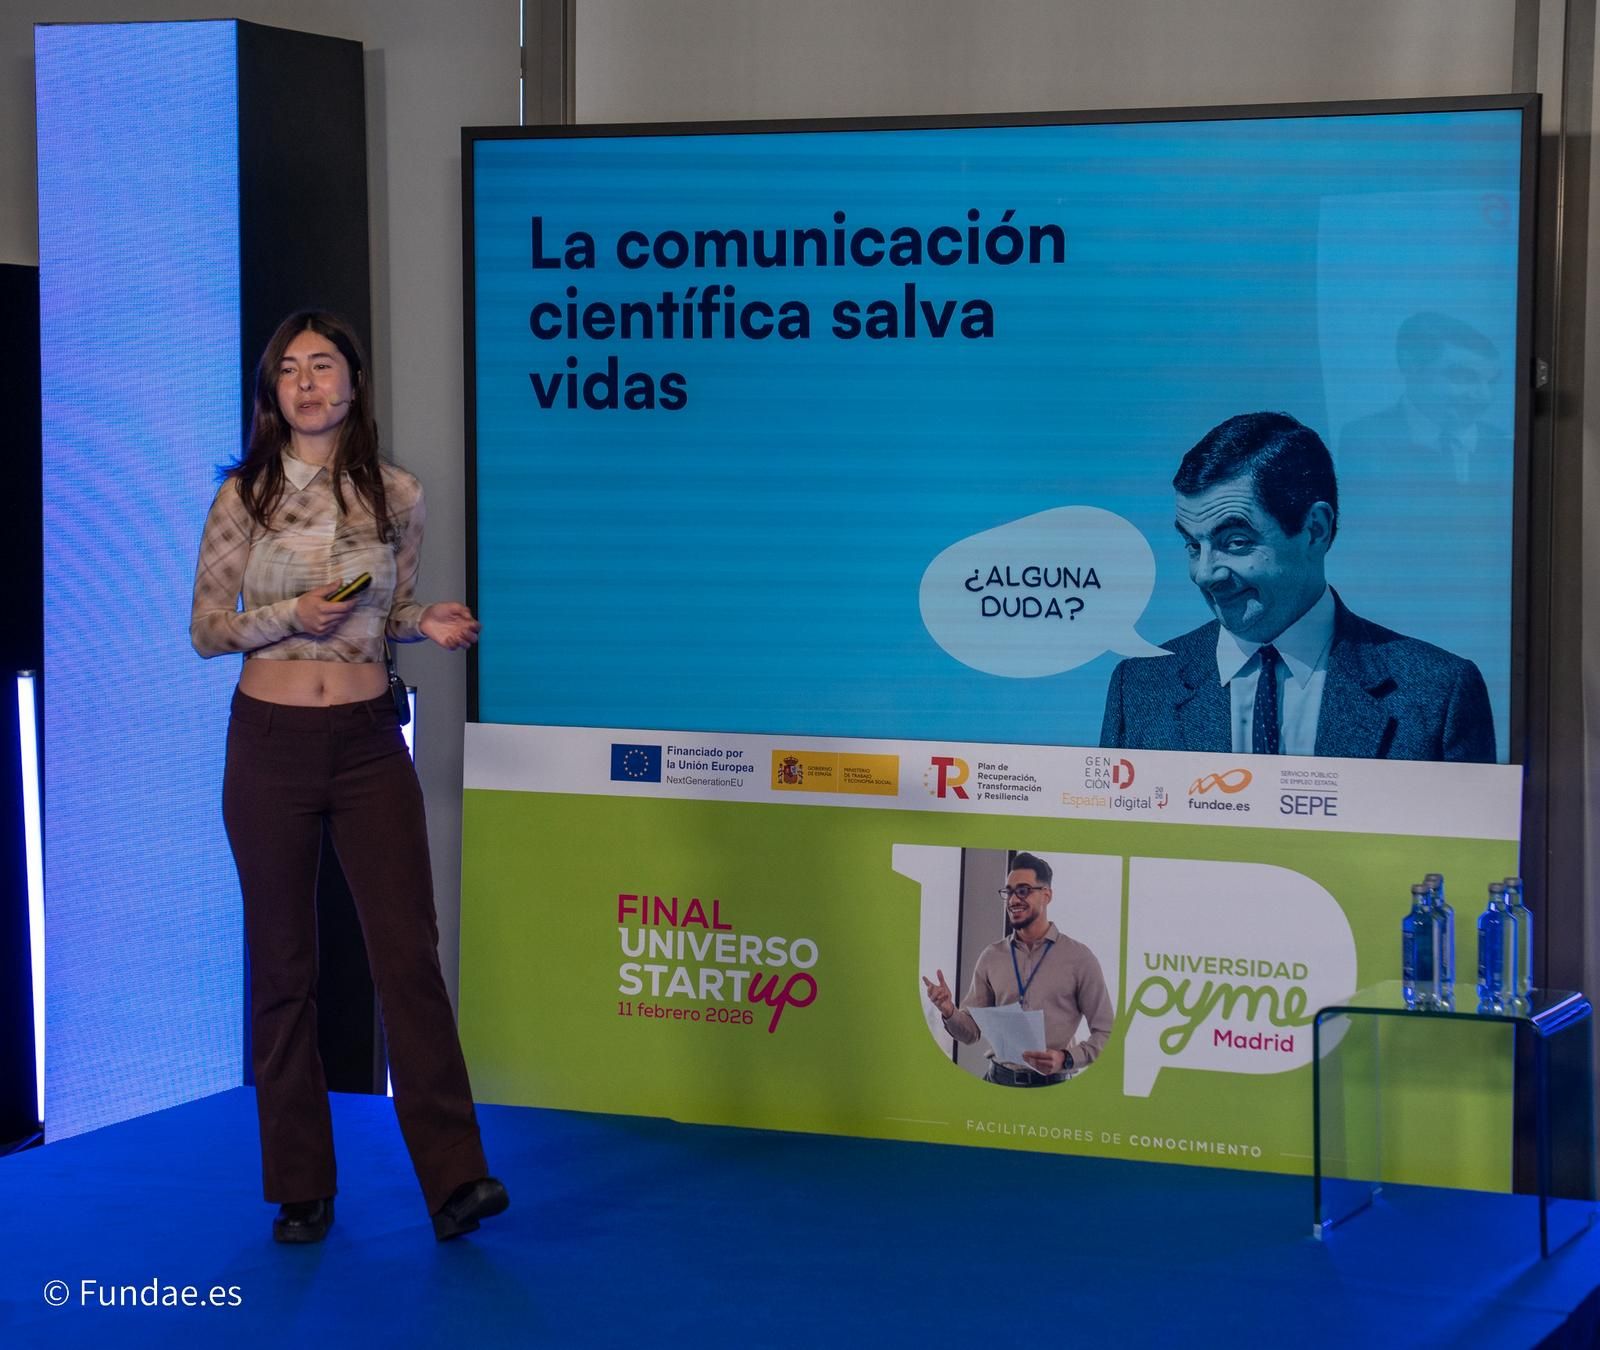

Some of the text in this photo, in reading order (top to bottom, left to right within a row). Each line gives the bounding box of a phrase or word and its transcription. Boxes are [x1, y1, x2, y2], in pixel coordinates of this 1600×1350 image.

[531, 208, 1066, 269] La comunicación
[529, 282, 995, 340] científica salva
[529, 355, 688, 410] vidas
[965, 565, 1101, 592] ¿ALGUNA
[981, 595, 1085, 620] DUDA?
[667, 745, 743, 760] Financiado por
[667, 759, 754, 773] la Unión Europea
[978, 762, 1009, 771] Plan de
[978, 772, 1037, 783] Recuperación,
[666, 775, 744, 788] NextGenerationEU
[978, 782, 1042, 792] Transformación
[985, 791, 1029, 801] Resiliencia
[1061, 791, 1152, 811] España digital
[1188, 798, 1251, 812] fundae.es
[1280, 794, 1338, 817] SEPE
[618, 894, 732, 930] FINAL
[618, 927, 819, 969] UNIVERSO
[1144, 952, 1309, 981] UNIVERSIDAD
[618, 1001, 754, 1025] 11 febrero 2026
[1126, 975, 1314, 1056] pyme
[1213, 1028, 1294, 1053] Madrid
[966, 1119, 1262, 1158] FACILITADORES DE CONOCIMIENTO
